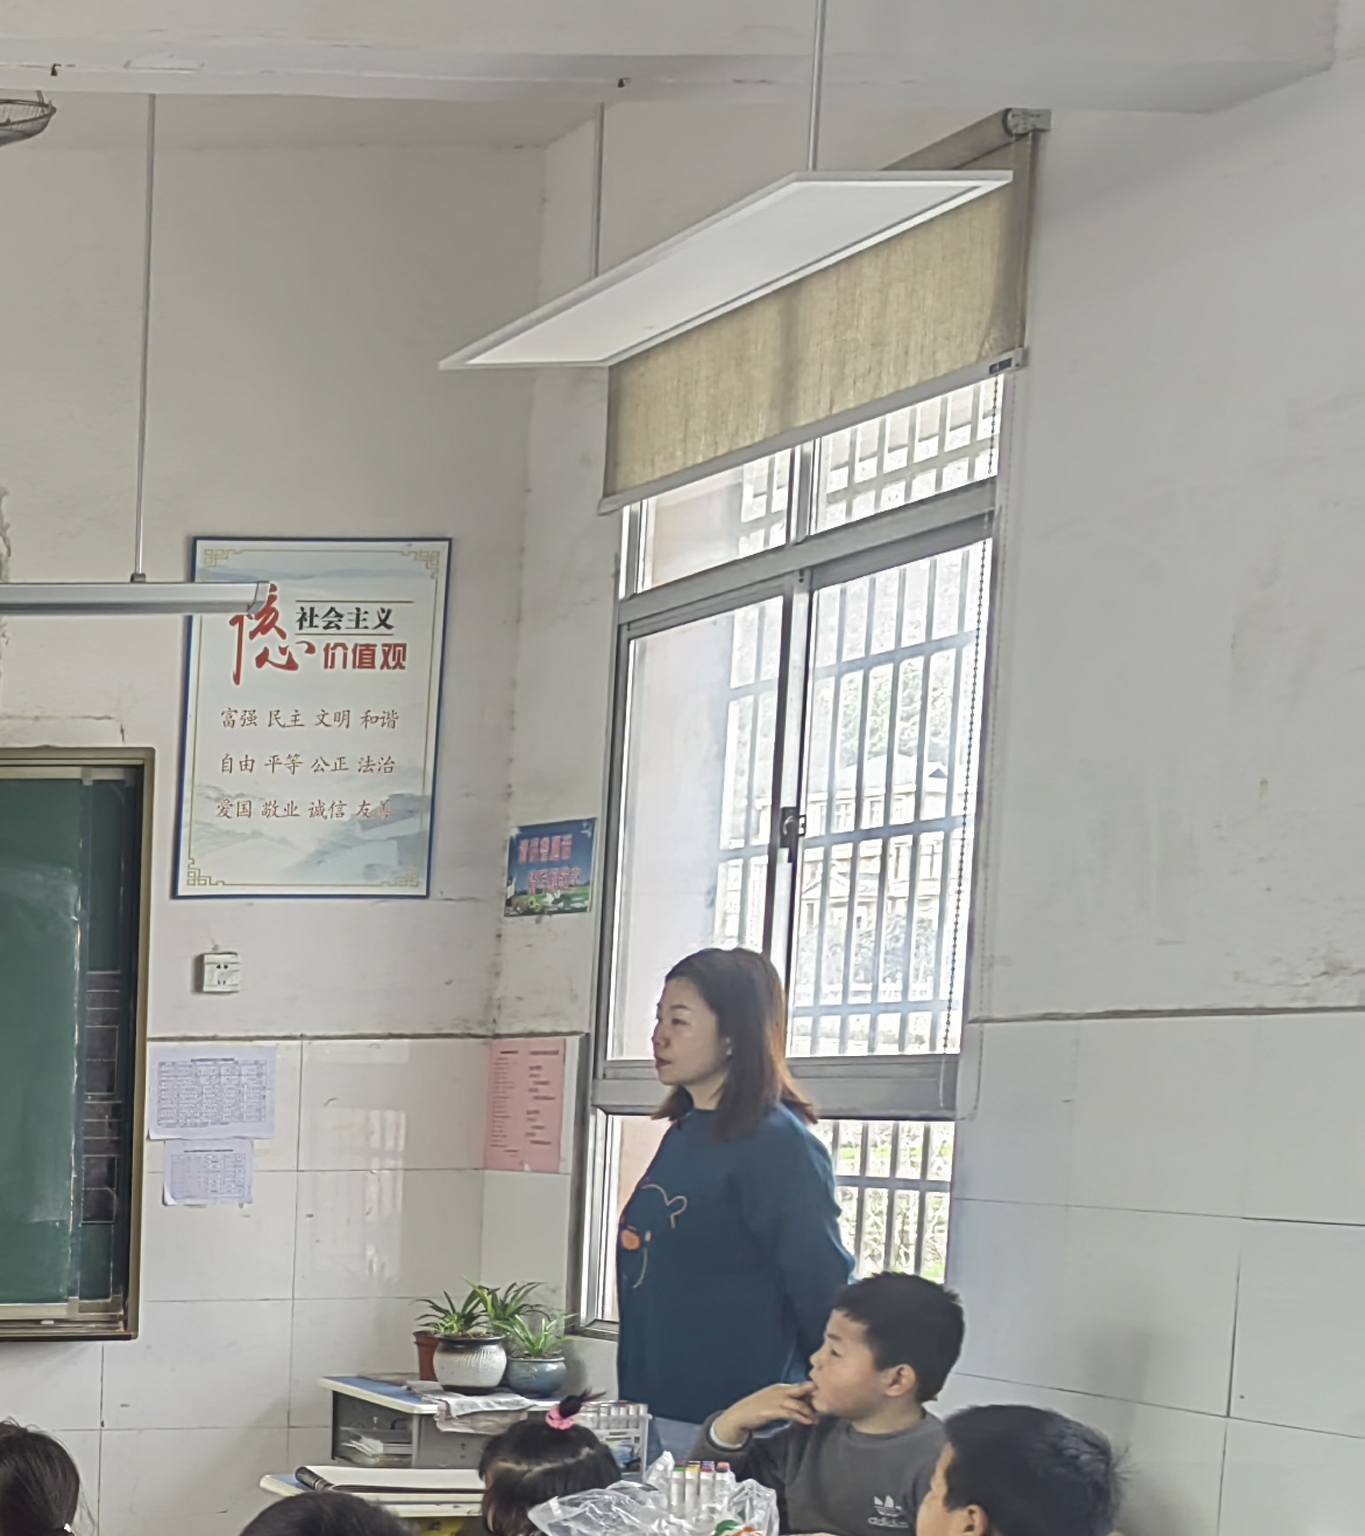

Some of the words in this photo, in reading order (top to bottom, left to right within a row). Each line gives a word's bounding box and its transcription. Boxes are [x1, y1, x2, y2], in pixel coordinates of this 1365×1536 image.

[295, 606, 395, 630] 社会主义
[323, 642, 407, 670] 价值观
[221, 708, 258, 729] 富强
[267, 710, 305, 728] 民主
[315, 709, 350, 728] 文明
[360, 709, 399, 729] 和谐
[220, 754, 254, 774] 自由
[265, 754, 302, 774] 平等
[311, 757, 349, 773] 公正
[357, 756, 395, 774] 法治
[217, 800, 252, 818] 爱国
[261, 801, 300, 818] 敬业
[308, 800, 347, 819] 诚信
